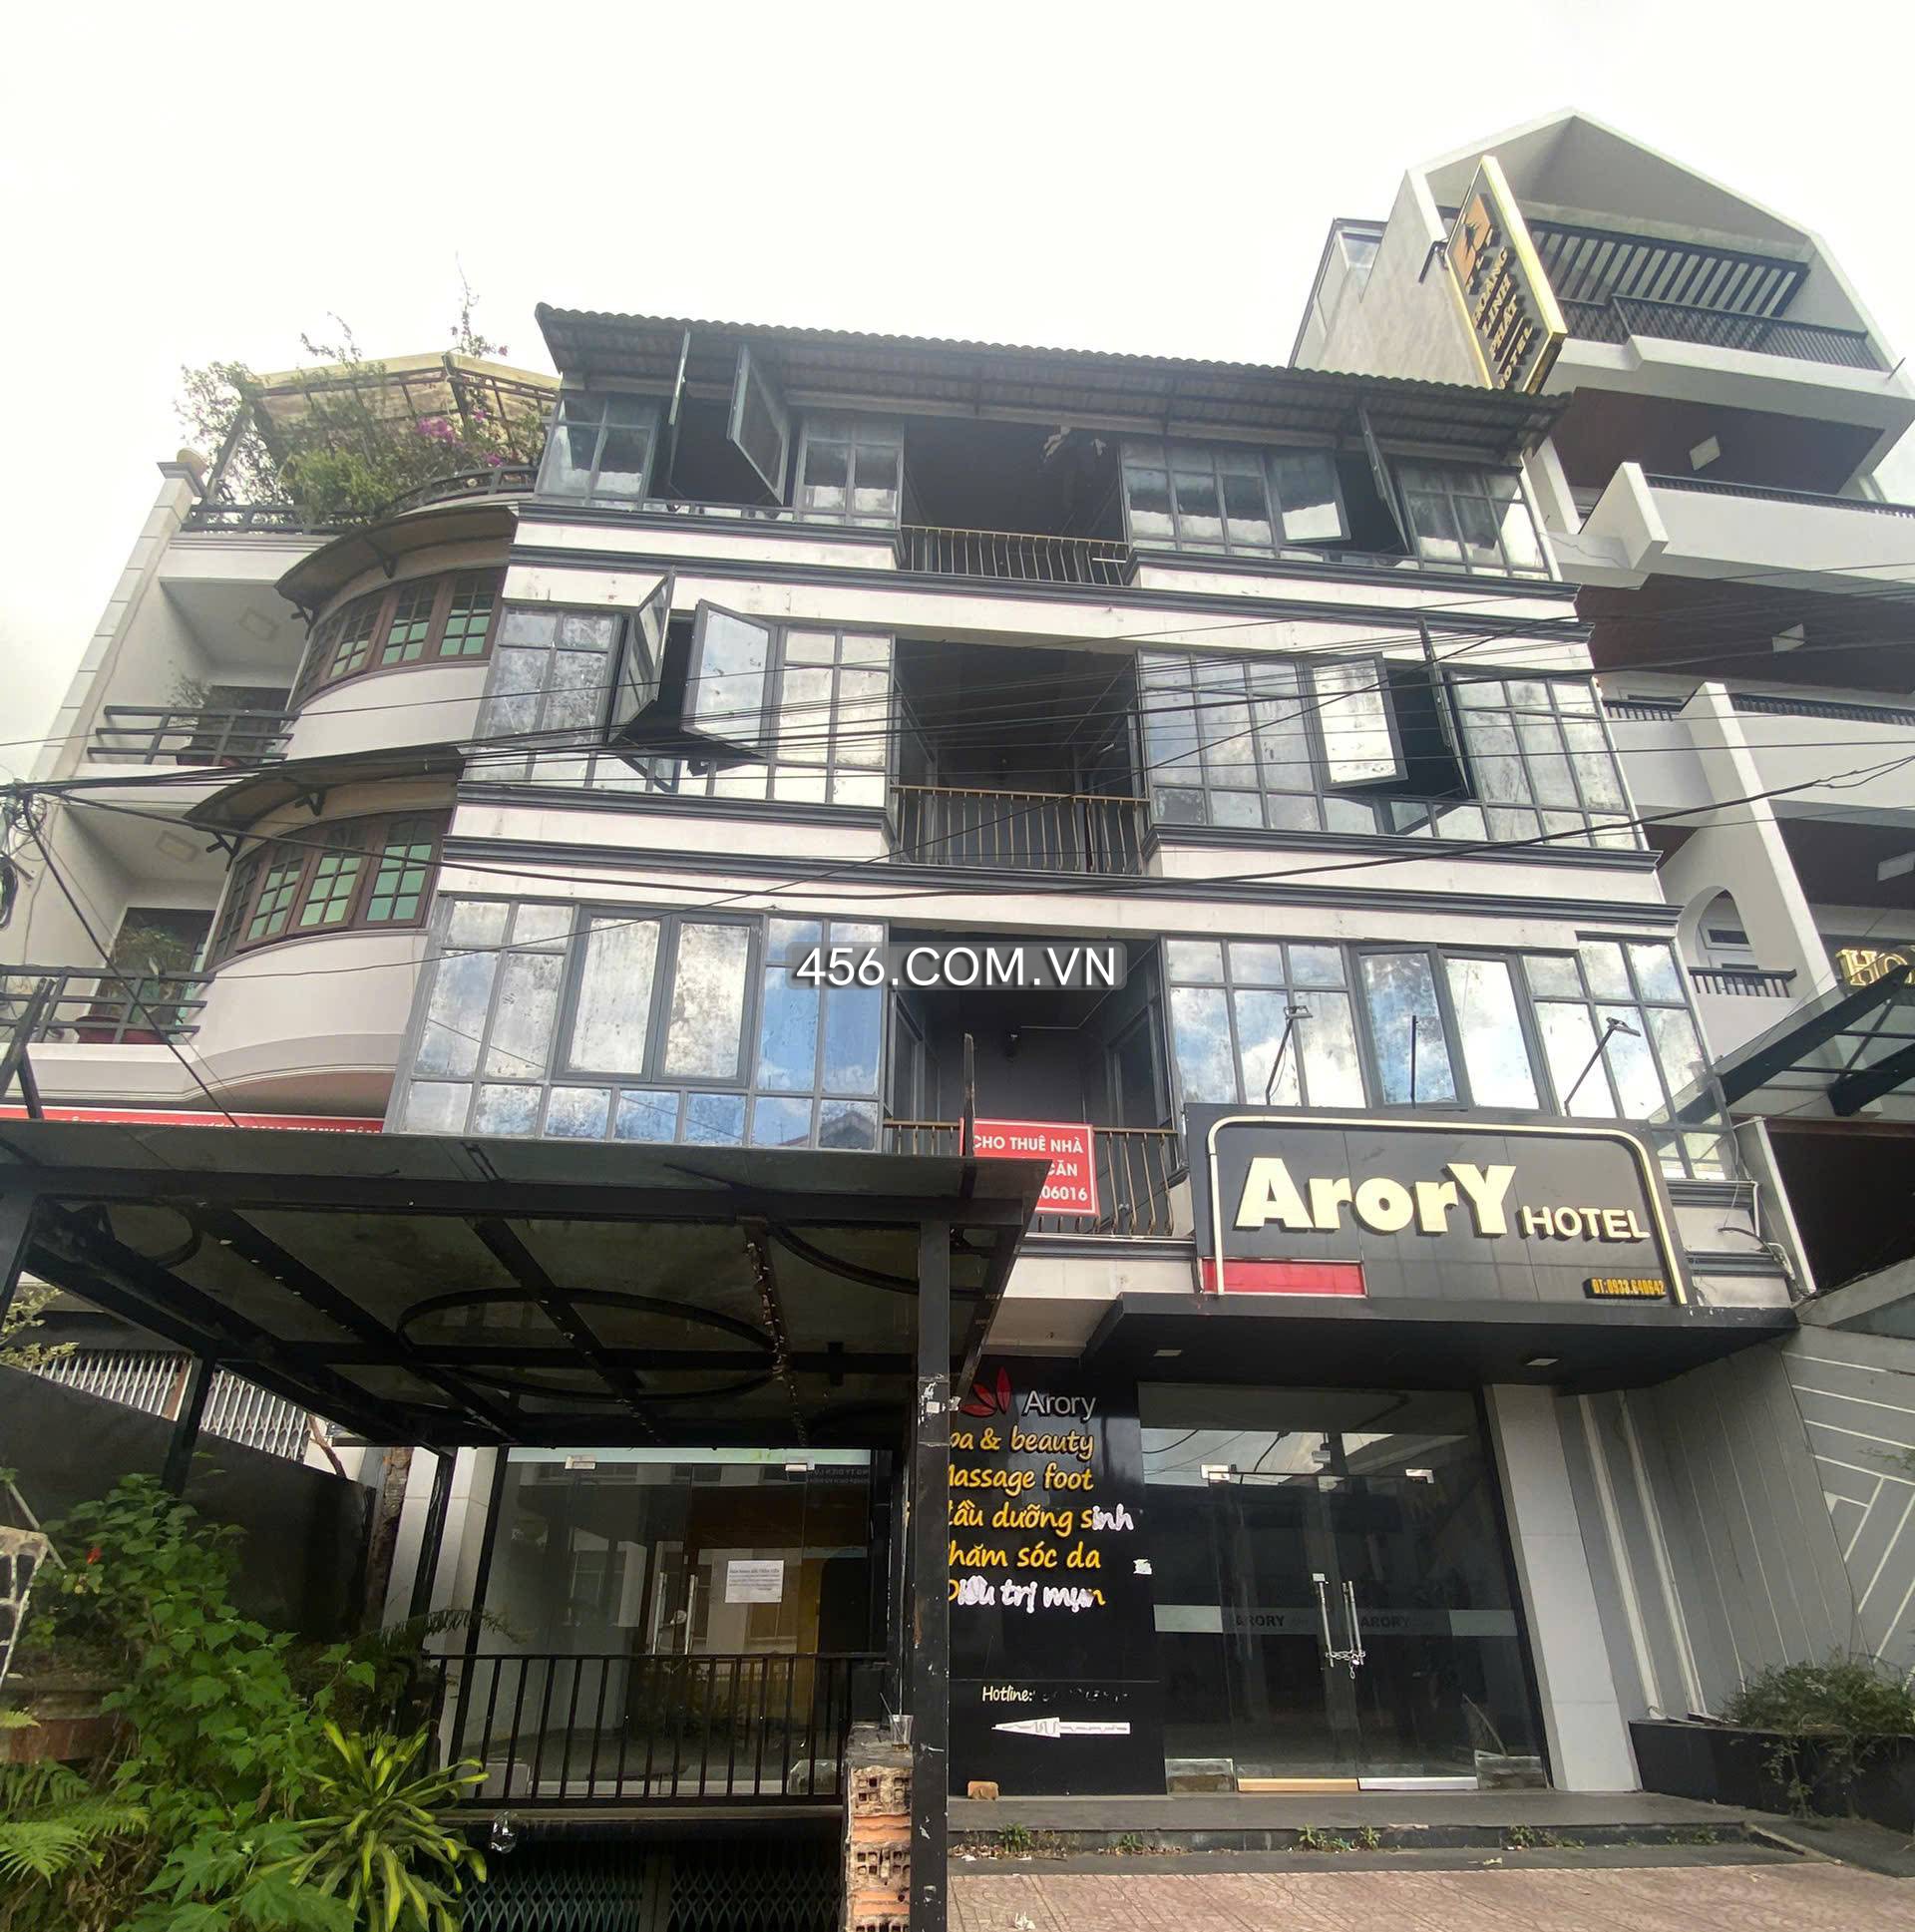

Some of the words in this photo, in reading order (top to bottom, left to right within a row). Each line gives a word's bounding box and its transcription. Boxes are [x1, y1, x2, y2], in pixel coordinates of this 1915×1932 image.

[973, 1134, 1005, 1149] CHO
[1009, 1135, 1046, 1152] THUÊ
[1050, 1137, 1083, 1154] NHÀ
[1039, 1185, 1088, 1202] 06016
[1521, 1205, 1652, 1240] HOTEL
[1023, 1389, 1096, 1420] Arory
[980, 1427, 1002, 1451] &
[1010, 1424, 1095, 1460] beauty
[1044, 1461, 1095, 1491] foot
[1080, 1503, 1135, 1532] sinh
[949, 1539, 1009, 1568] hăm
[1016, 1540, 1058, 1568] sóc
[1066, 1540, 1102, 1569] da
[981, 1685, 1033, 1702] Hotline:
